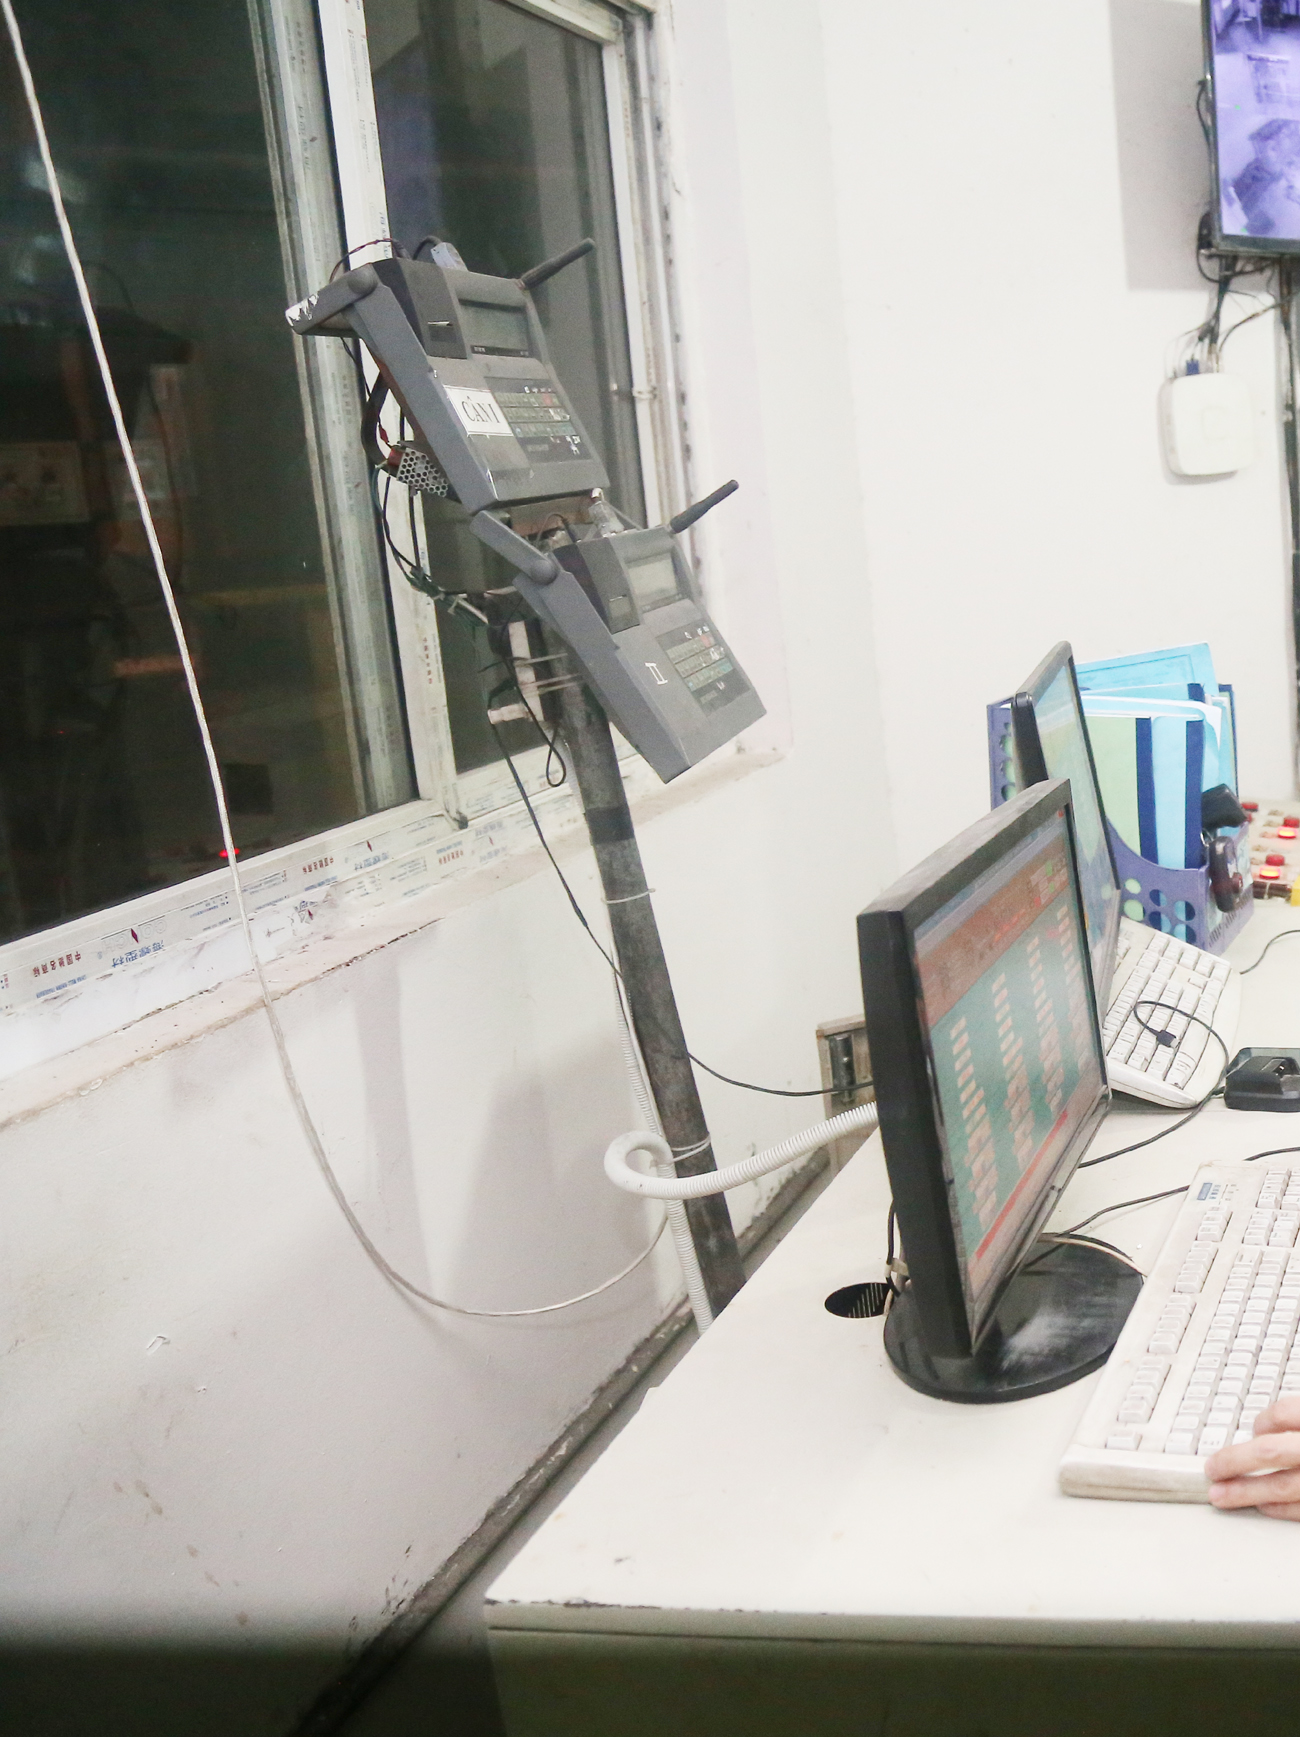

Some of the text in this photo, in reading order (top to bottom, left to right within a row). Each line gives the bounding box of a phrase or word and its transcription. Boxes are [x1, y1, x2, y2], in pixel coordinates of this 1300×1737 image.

[461, 395, 491, 423] CÂN
[111, 939, 164, 969] 海螺型材
